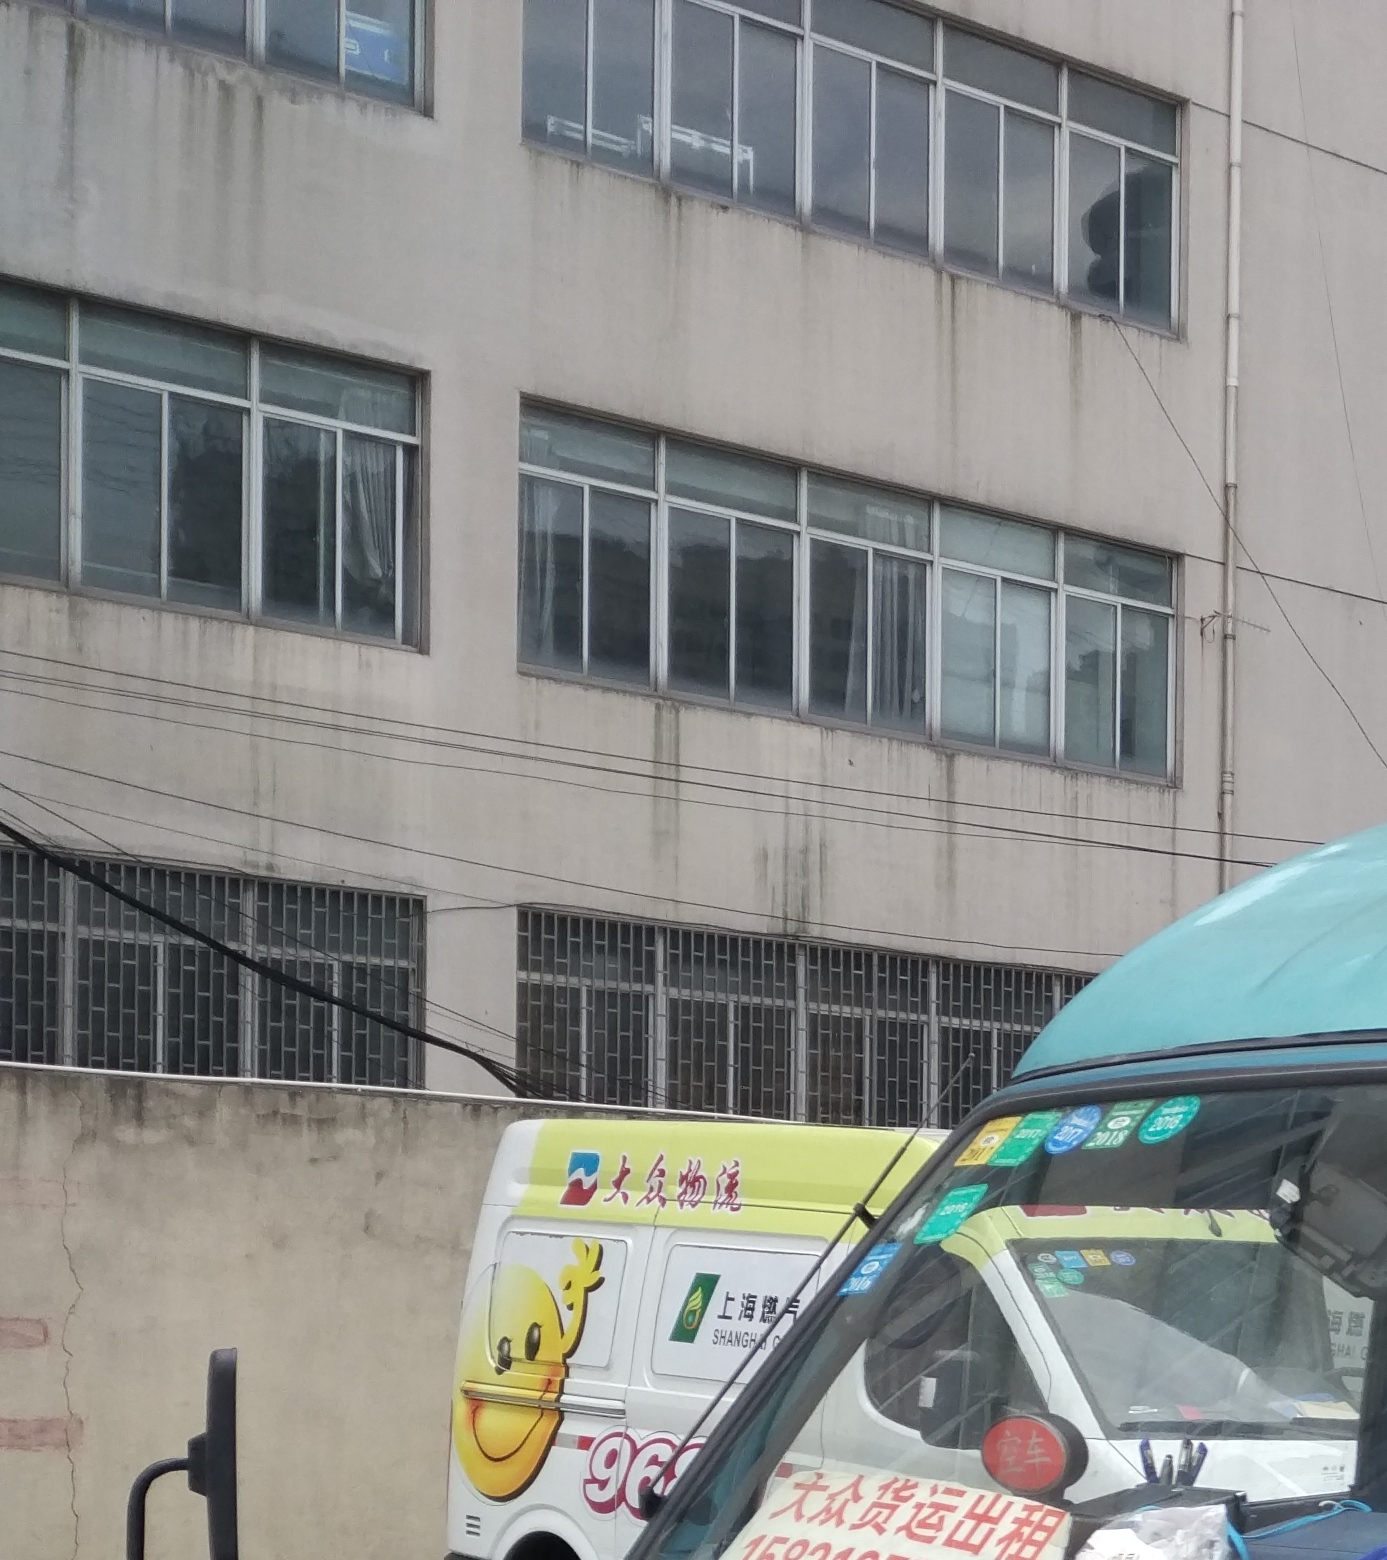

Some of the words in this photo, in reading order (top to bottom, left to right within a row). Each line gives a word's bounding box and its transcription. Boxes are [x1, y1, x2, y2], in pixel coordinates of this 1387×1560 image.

[1086, 1130, 1129, 1147] 2018
[603, 1153, 742, 1211] 大众物流
